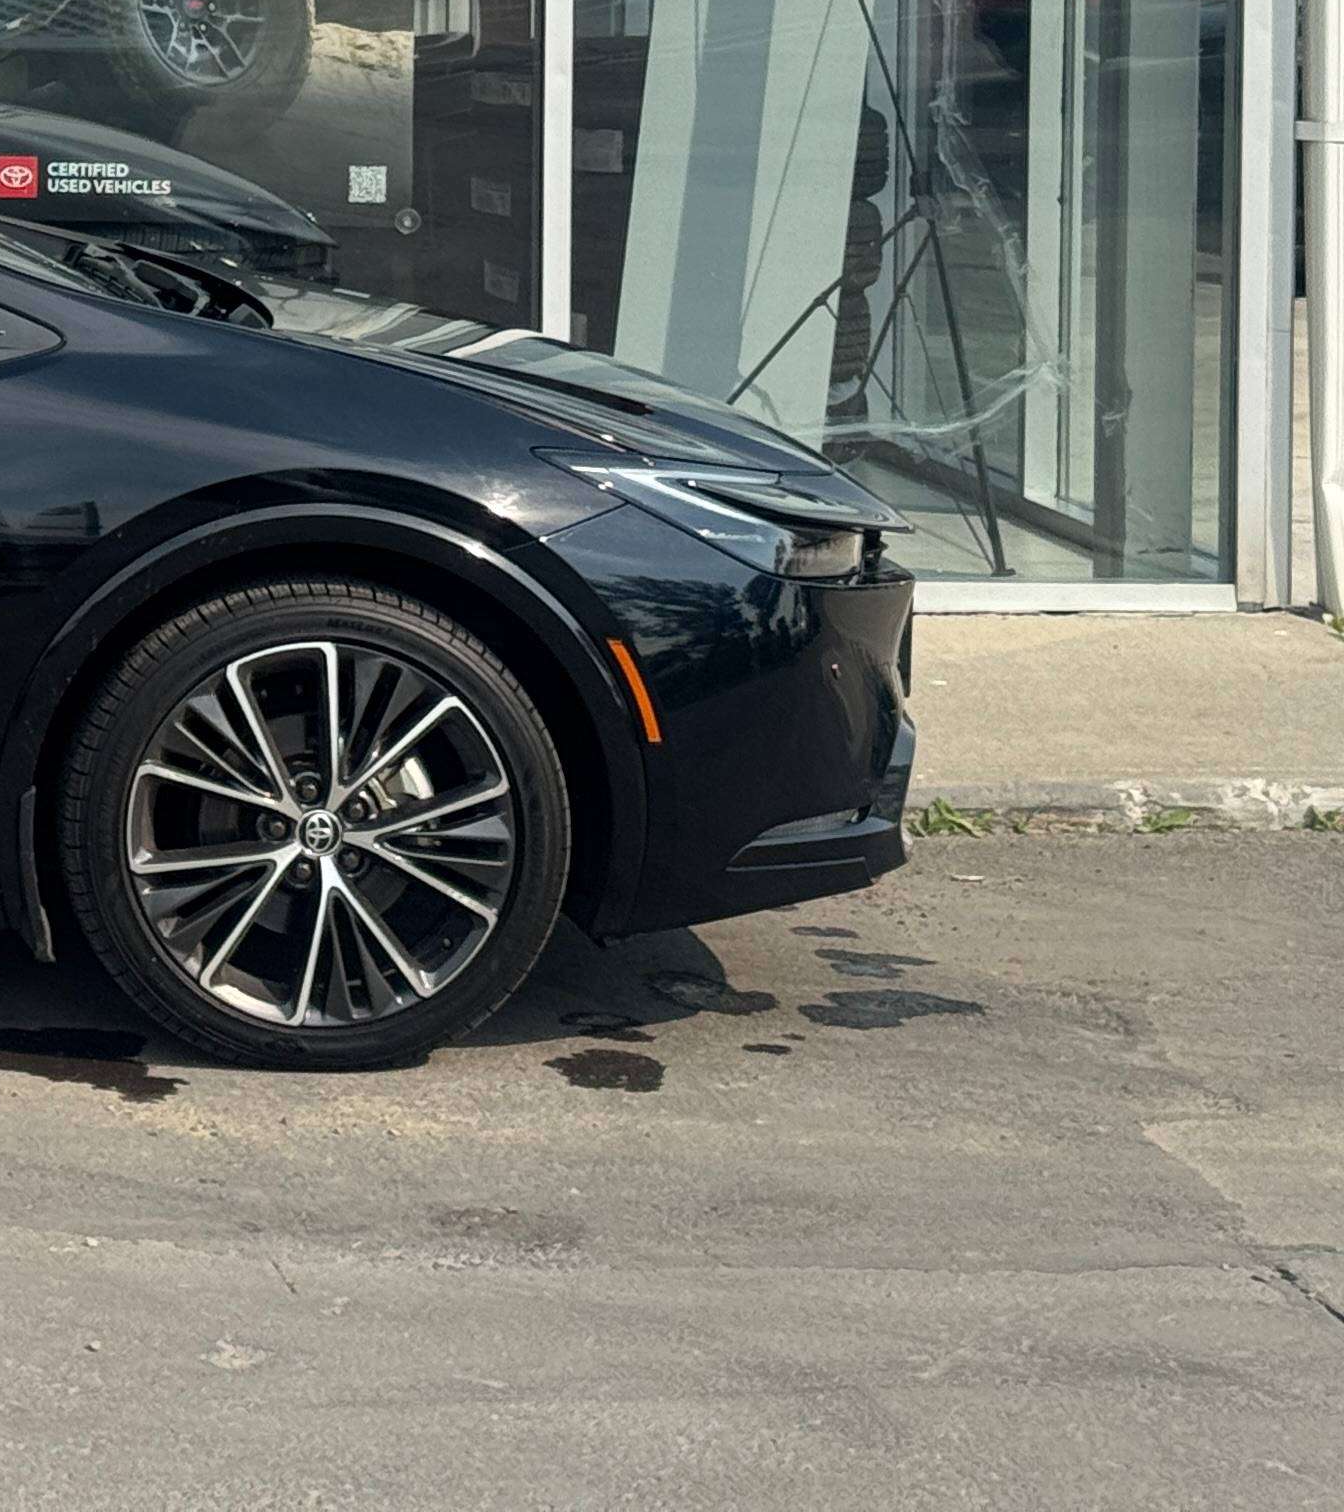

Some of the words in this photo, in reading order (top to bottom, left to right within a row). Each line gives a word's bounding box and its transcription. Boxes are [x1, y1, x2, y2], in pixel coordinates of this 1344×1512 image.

[47, 162, 130, 178] CERTIFIED
[47, 178, 92, 193] USED
[93, 179, 172, 195] VEHICLES
